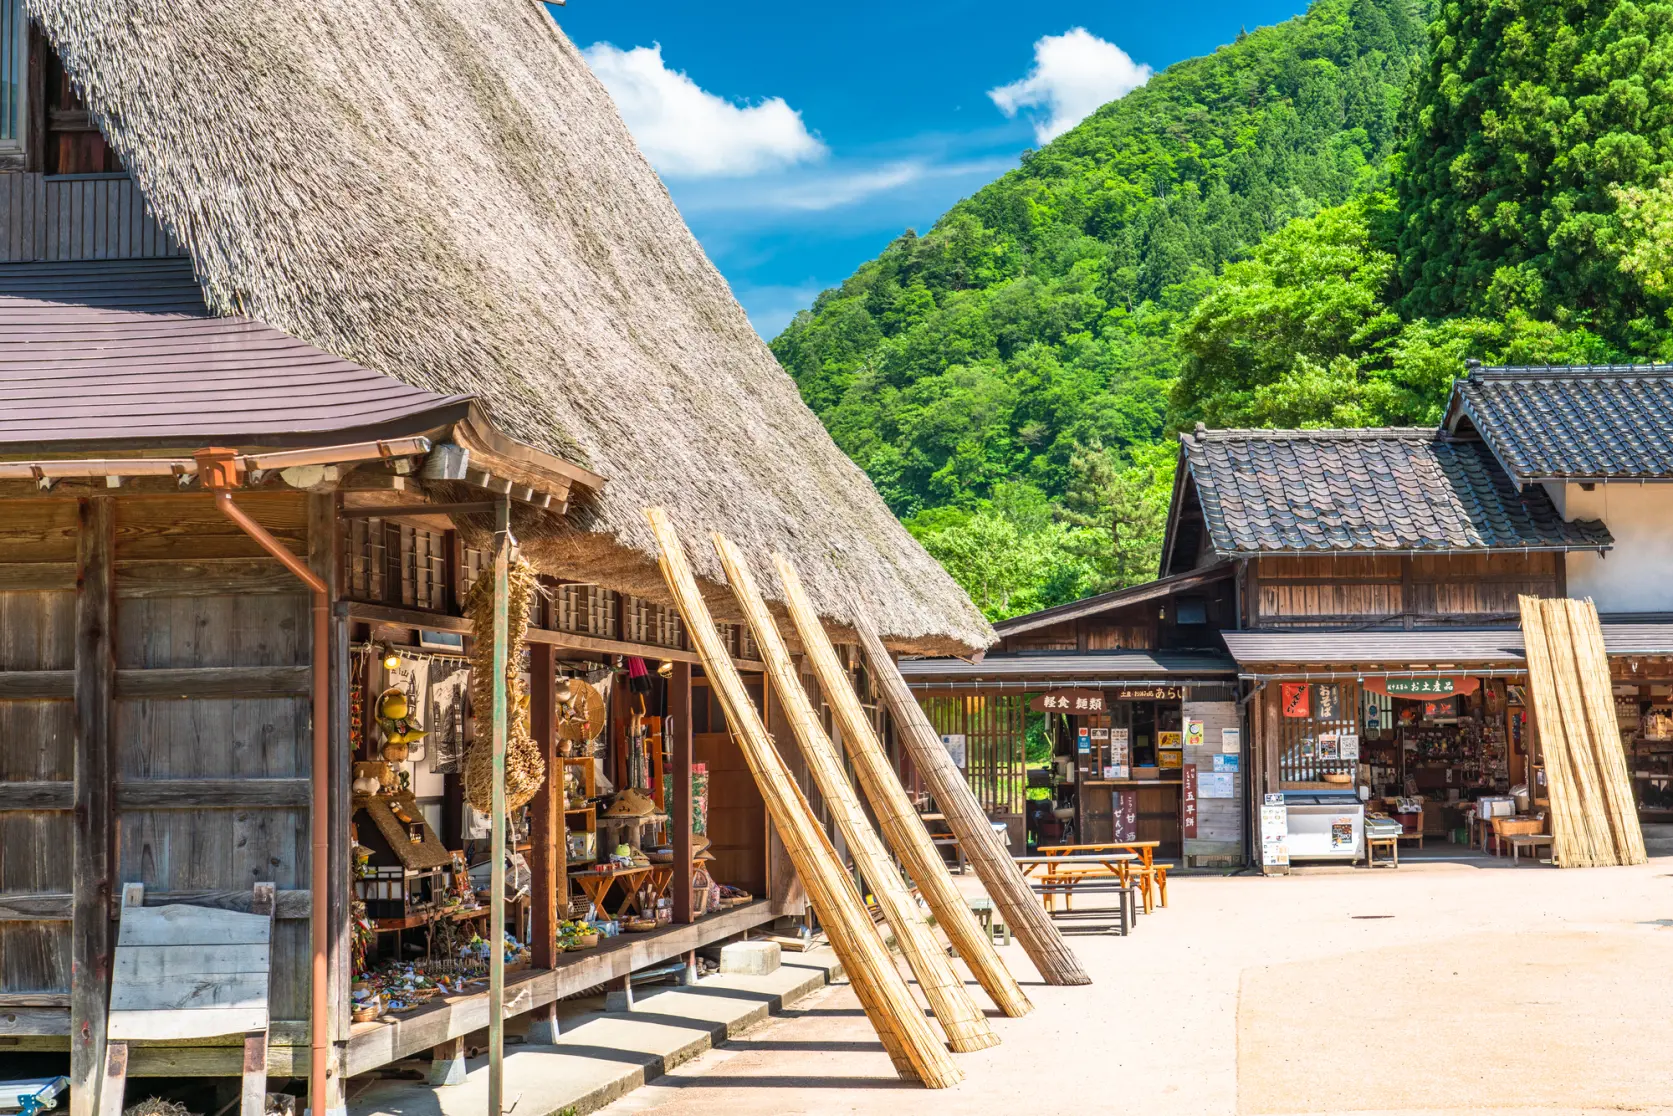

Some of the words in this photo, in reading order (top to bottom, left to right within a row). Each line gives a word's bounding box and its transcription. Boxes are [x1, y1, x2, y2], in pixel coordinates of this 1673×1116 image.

[1319, 684, 1333, 718] おそば
[1411, 680, 1454, 692] お土産品
[1043, 695, 1070, 708] 軽食
[1075, 696, 1102, 711] 麺類
[1185, 791, 1196, 828] 五平餅
[1113, 807, 1125, 844] ぜんざい
[1126, 813, 1136, 842] 甘酒
